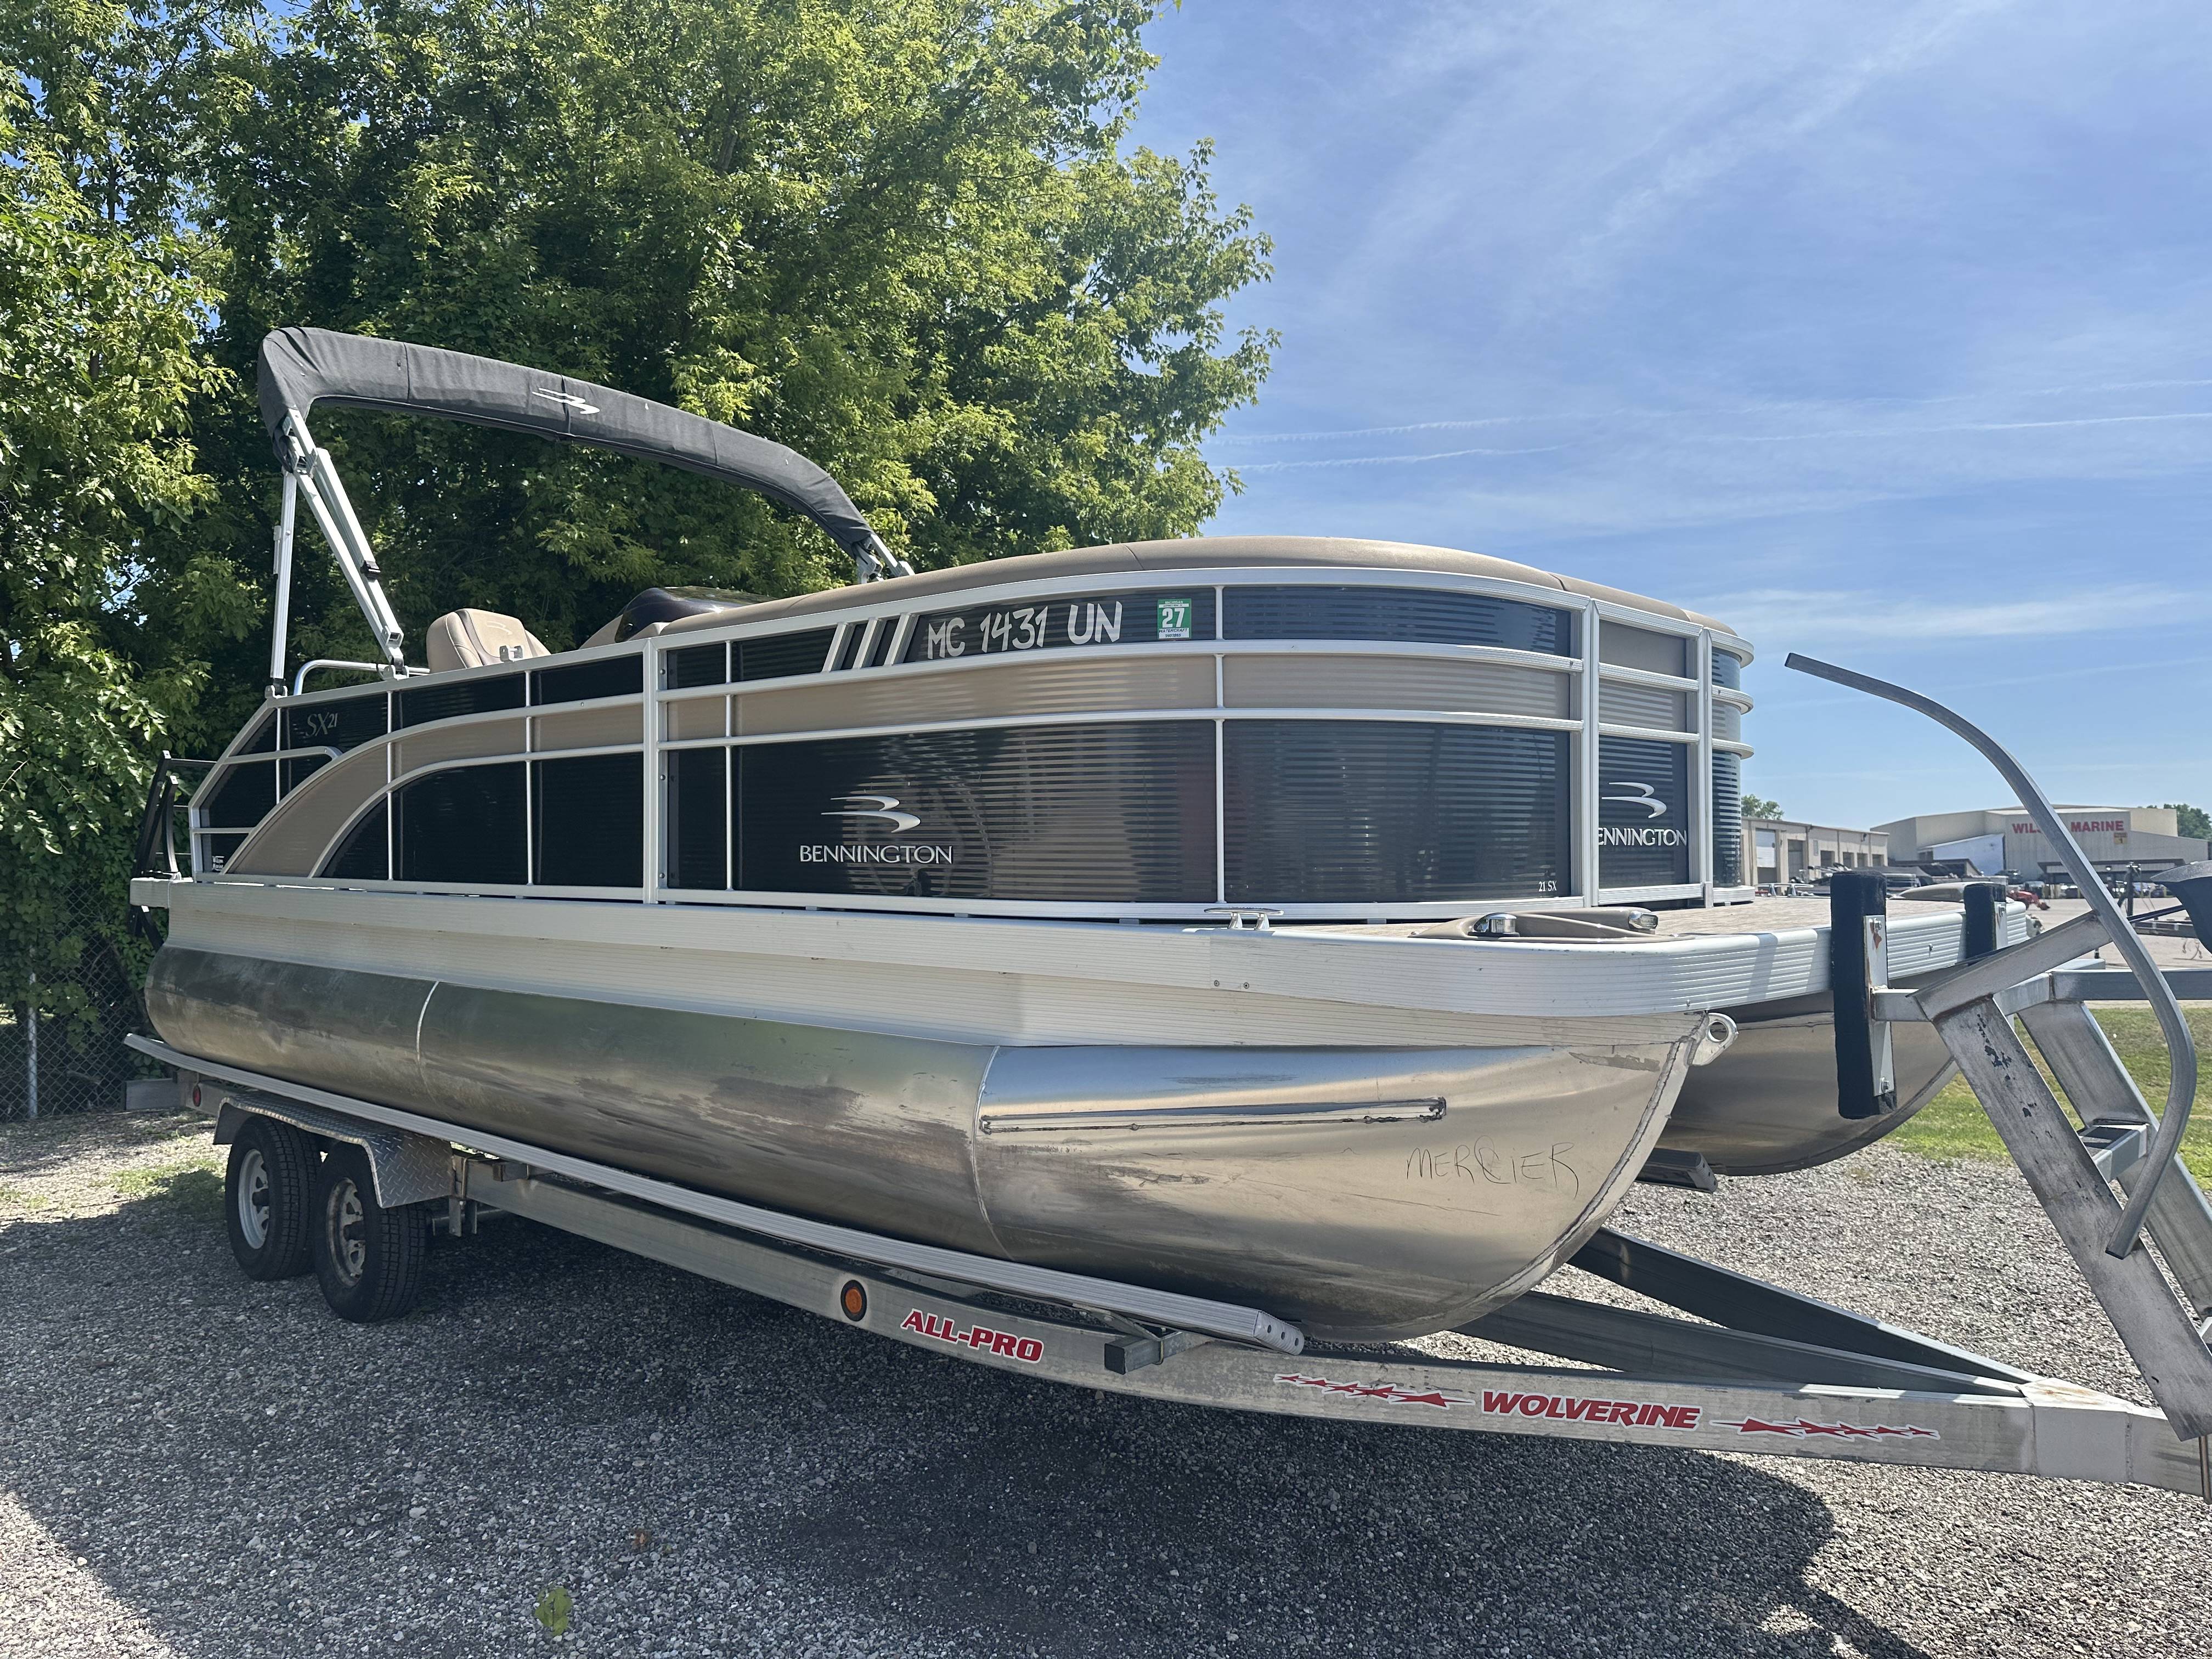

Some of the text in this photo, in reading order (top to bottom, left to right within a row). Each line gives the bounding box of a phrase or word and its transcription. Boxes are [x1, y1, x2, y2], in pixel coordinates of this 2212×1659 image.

[1162, 607, 1185, 628] 27
[927, 601, 1122, 659] MC 1431 UN
[2070, 820, 2124, 832] MARINE
[1598, 827, 1686, 846] ENNINGTON
[799, 845, 953, 864] BENNINGTON
[1538, 880, 1557, 892] 21 SX
[901, 1310, 1043, 1363] ALL-PRO
[1483, 1391, 1701, 1429] WOLVERINE
